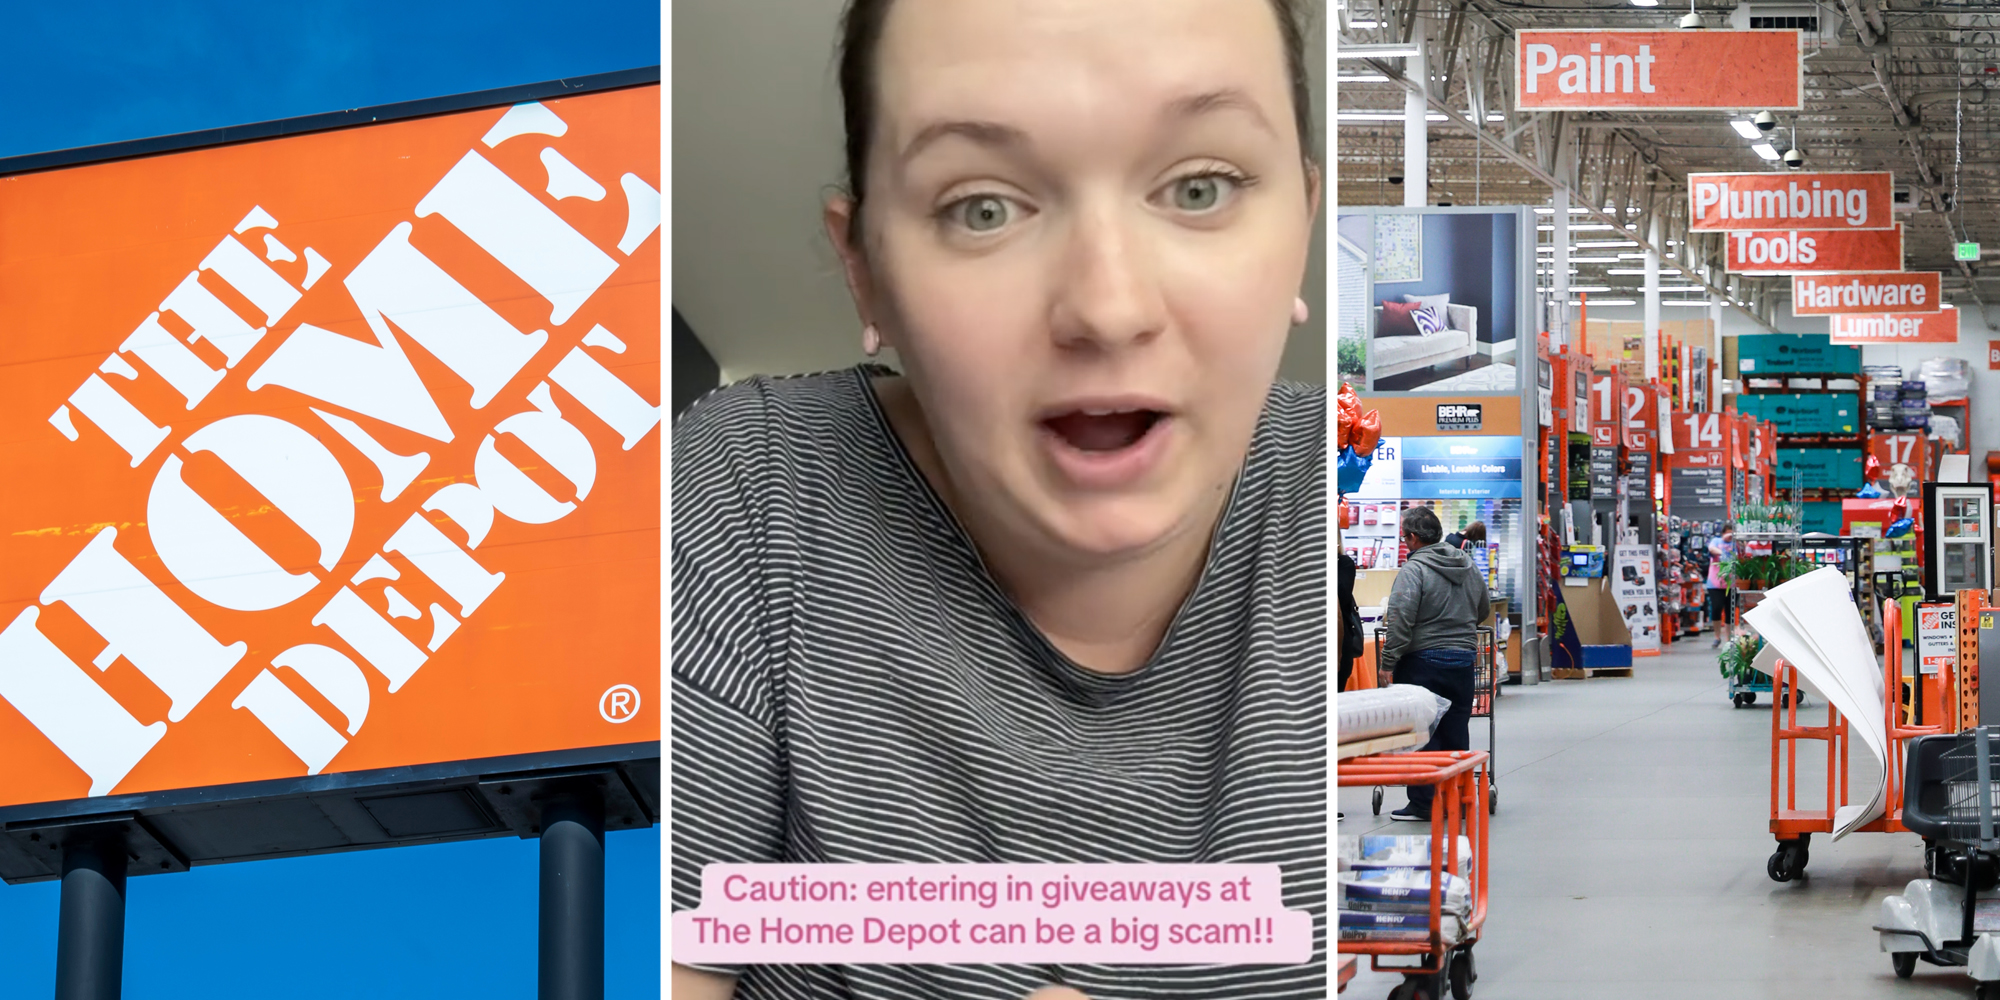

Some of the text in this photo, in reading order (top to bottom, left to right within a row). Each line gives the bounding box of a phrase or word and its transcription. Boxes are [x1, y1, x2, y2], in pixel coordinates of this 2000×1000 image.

[1526, 43, 1656, 95] Paint
[1695, 181, 1869, 227] Plumbing
[1732, 232, 1817, 265] Tools
[1959, 244, 1977, 259] EXIT
[1796, 280, 1927, 310] Hardware
[48, 205, 332, 468] THE
[1834, 313, 1924, 338] Lumber
[1438, 405, 1467, 418] BEHR
[1684, 413, 1723, 448] 14
[0, 101, 661, 798] HOME
[1885, 435, 1917, 464] 17
[1421, 464, 1505, 474] Livable, Lovable Colors
[232, 323, 661, 776] DEPOT
[1381, 887, 1410, 896] HENRY
[1375, 915, 1405, 923] HENRY
